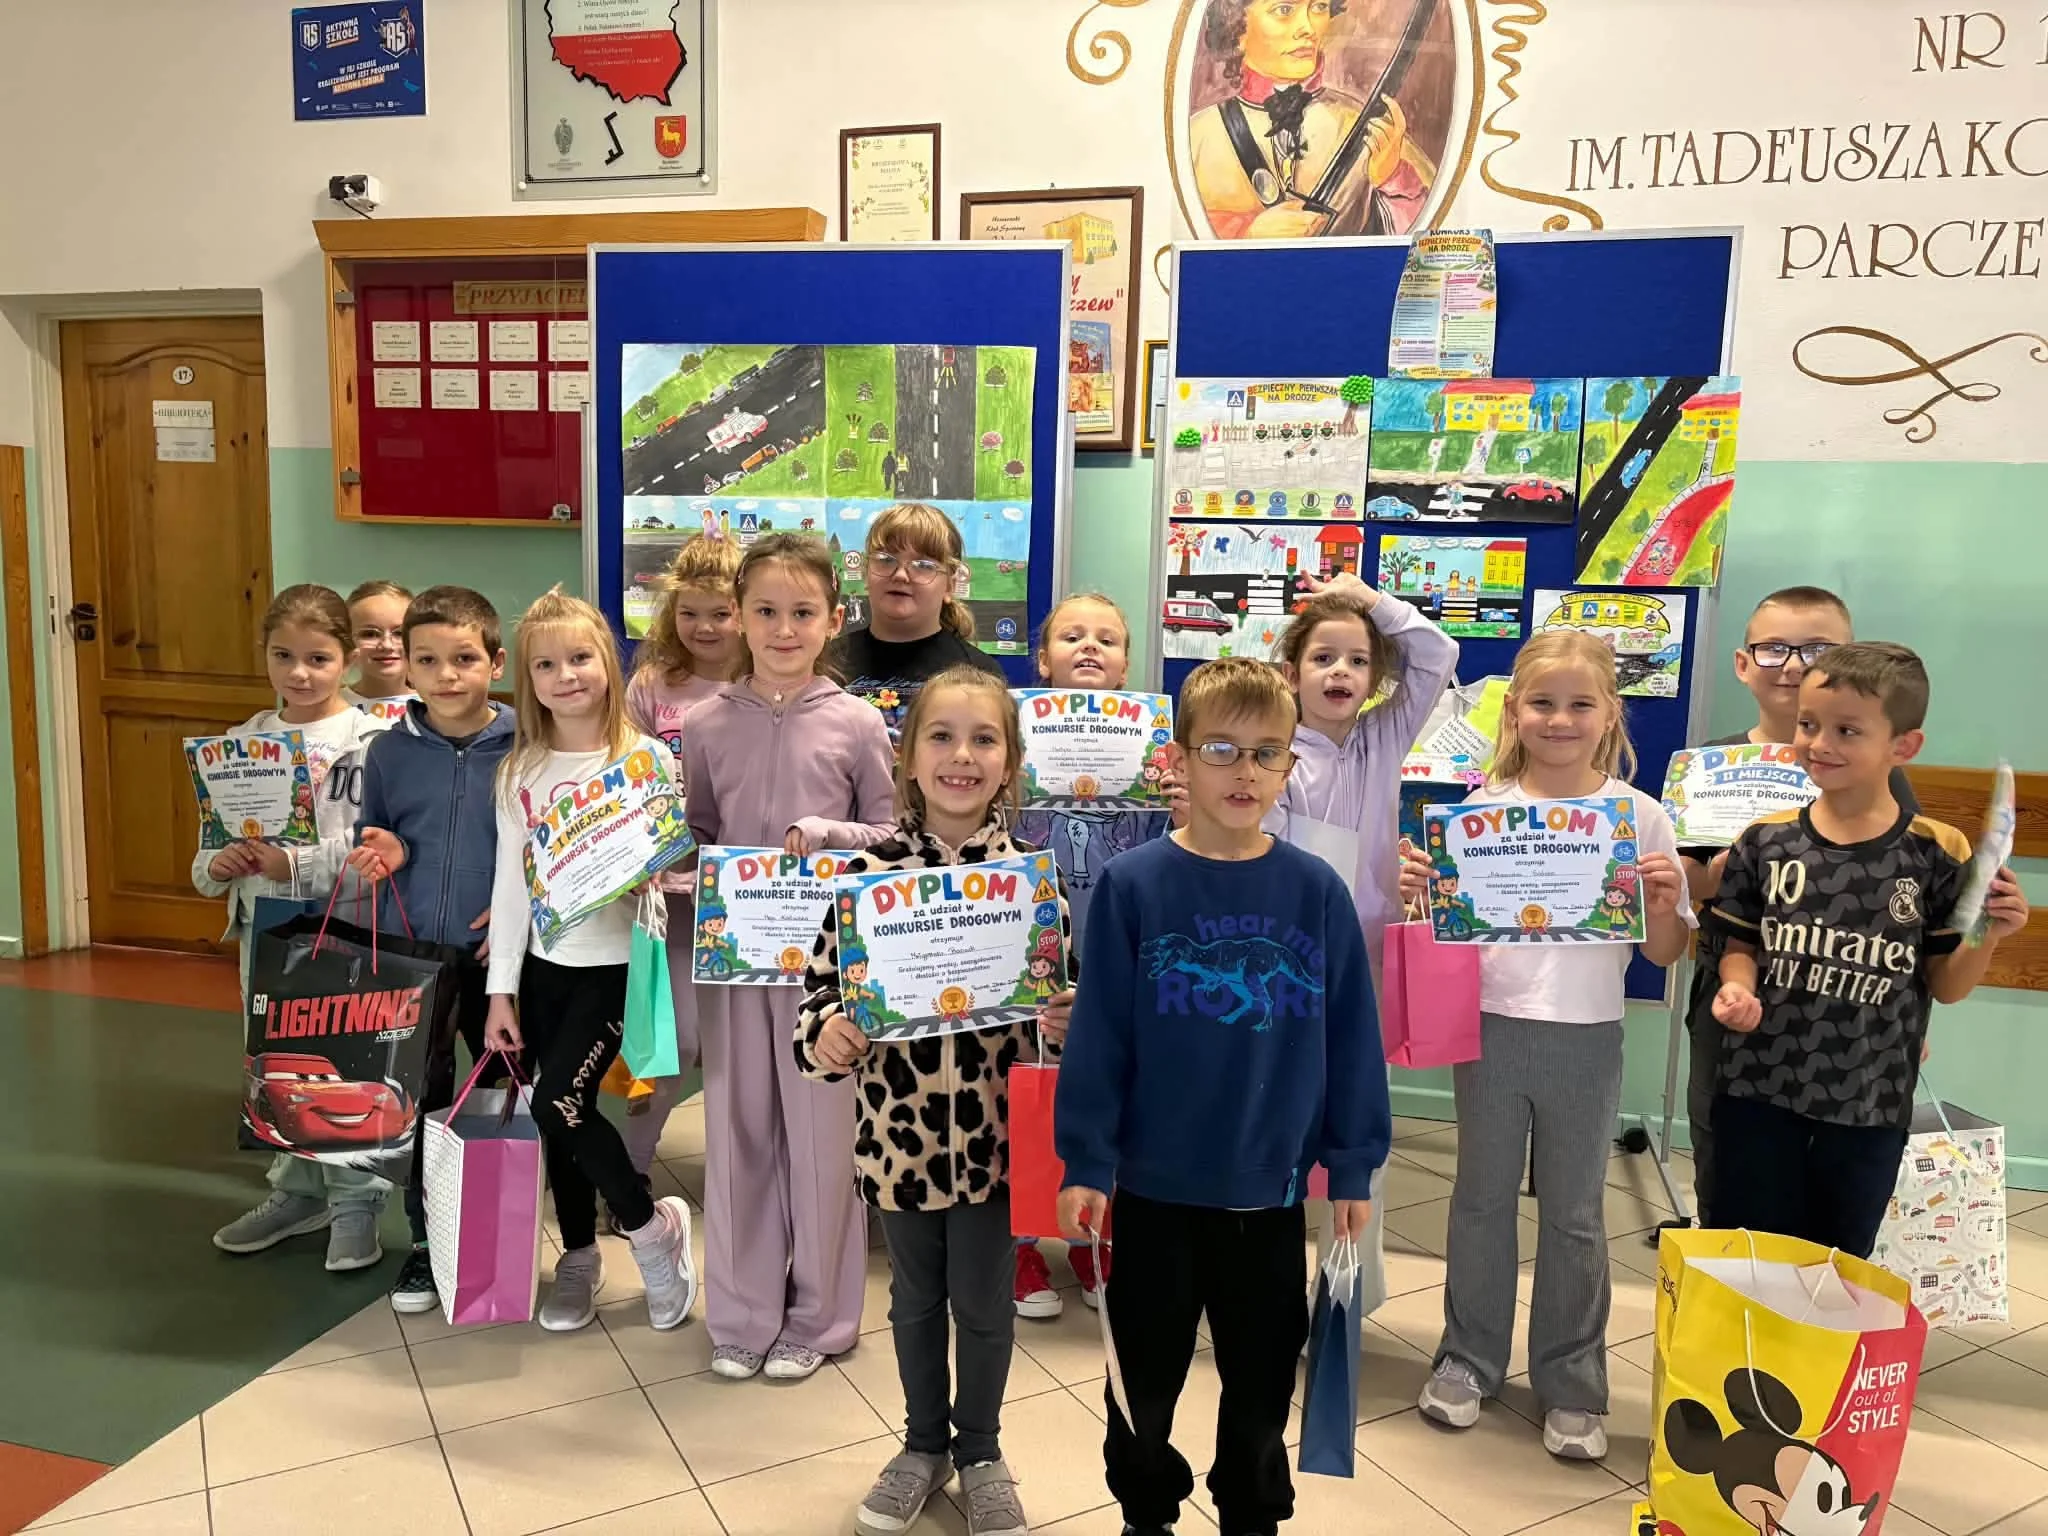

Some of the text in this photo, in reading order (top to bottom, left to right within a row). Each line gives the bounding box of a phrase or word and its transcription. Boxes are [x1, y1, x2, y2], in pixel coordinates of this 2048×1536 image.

[326, 17, 359, 33] AKTYWNA
[1912, 12, 2006, 72] NR
[1642, 121, 1954, 189] TADEUSZA
[1777, 217, 2045, 280] PARCZE
[1247, 383, 1338, 396] BEZPIECZNY PIERWSZAK
[1285, 393, 1317, 401] DRODZE
[847, 553, 860, 565] 20
[1033, 693, 1142, 722] DYPLOM
[1031, 724, 1142, 737] KONKURSIE DROGOWYM
[201, 737, 281, 767] DYPLOM
[1702, 744, 1801, 771] DYPLO
[243, 768, 287, 778] DROGOWYM
[1738, 769, 1798, 784] MIEJSCA
[536, 766, 626, 849] DYPLOM
[1693, 789, 1753, 799] KONKURSIE
[565, 803, 614, 838] MIEJSCA
[1461, 805, 1597, 840] DYPLOM
[545, 839, 590, 883] KONKURSIE
[591, 807, 644, 845] DROGOWYM
[1463, 843, 1600, 858] KONKURSIE DROGOWYM
[1516, 832, 1545, 842] udział
[1548, 833, 1556, 841] w
[1616, 870, 1636, 881] STOP
[1766, 860, 1806, 905] 10
[735, 889, 834, 901] KONKURSIE DROGO
[871, 872, 1017, 915] DYPLOM
[873, 909, 1022, 938] KONKURSIE DROGOWYM
[913, 903, 975, 918] za udział w
[1039, 934, 1059, 946] STOP
[1193, 913, 1278, 941] hear
[1761, 916, 1917, 974] Emirates
[1764, 957, 1892, 1006] FLY BETTER
[253, 993, 268, 1015] GO
[265, 986, 424, 1040] LIGHTNING
[1855, 1361, 1909, 1392] NEVER
[1855, 1387, 1898, 1406] out of
[1848, 1404, 1902, 1435] STYLE
